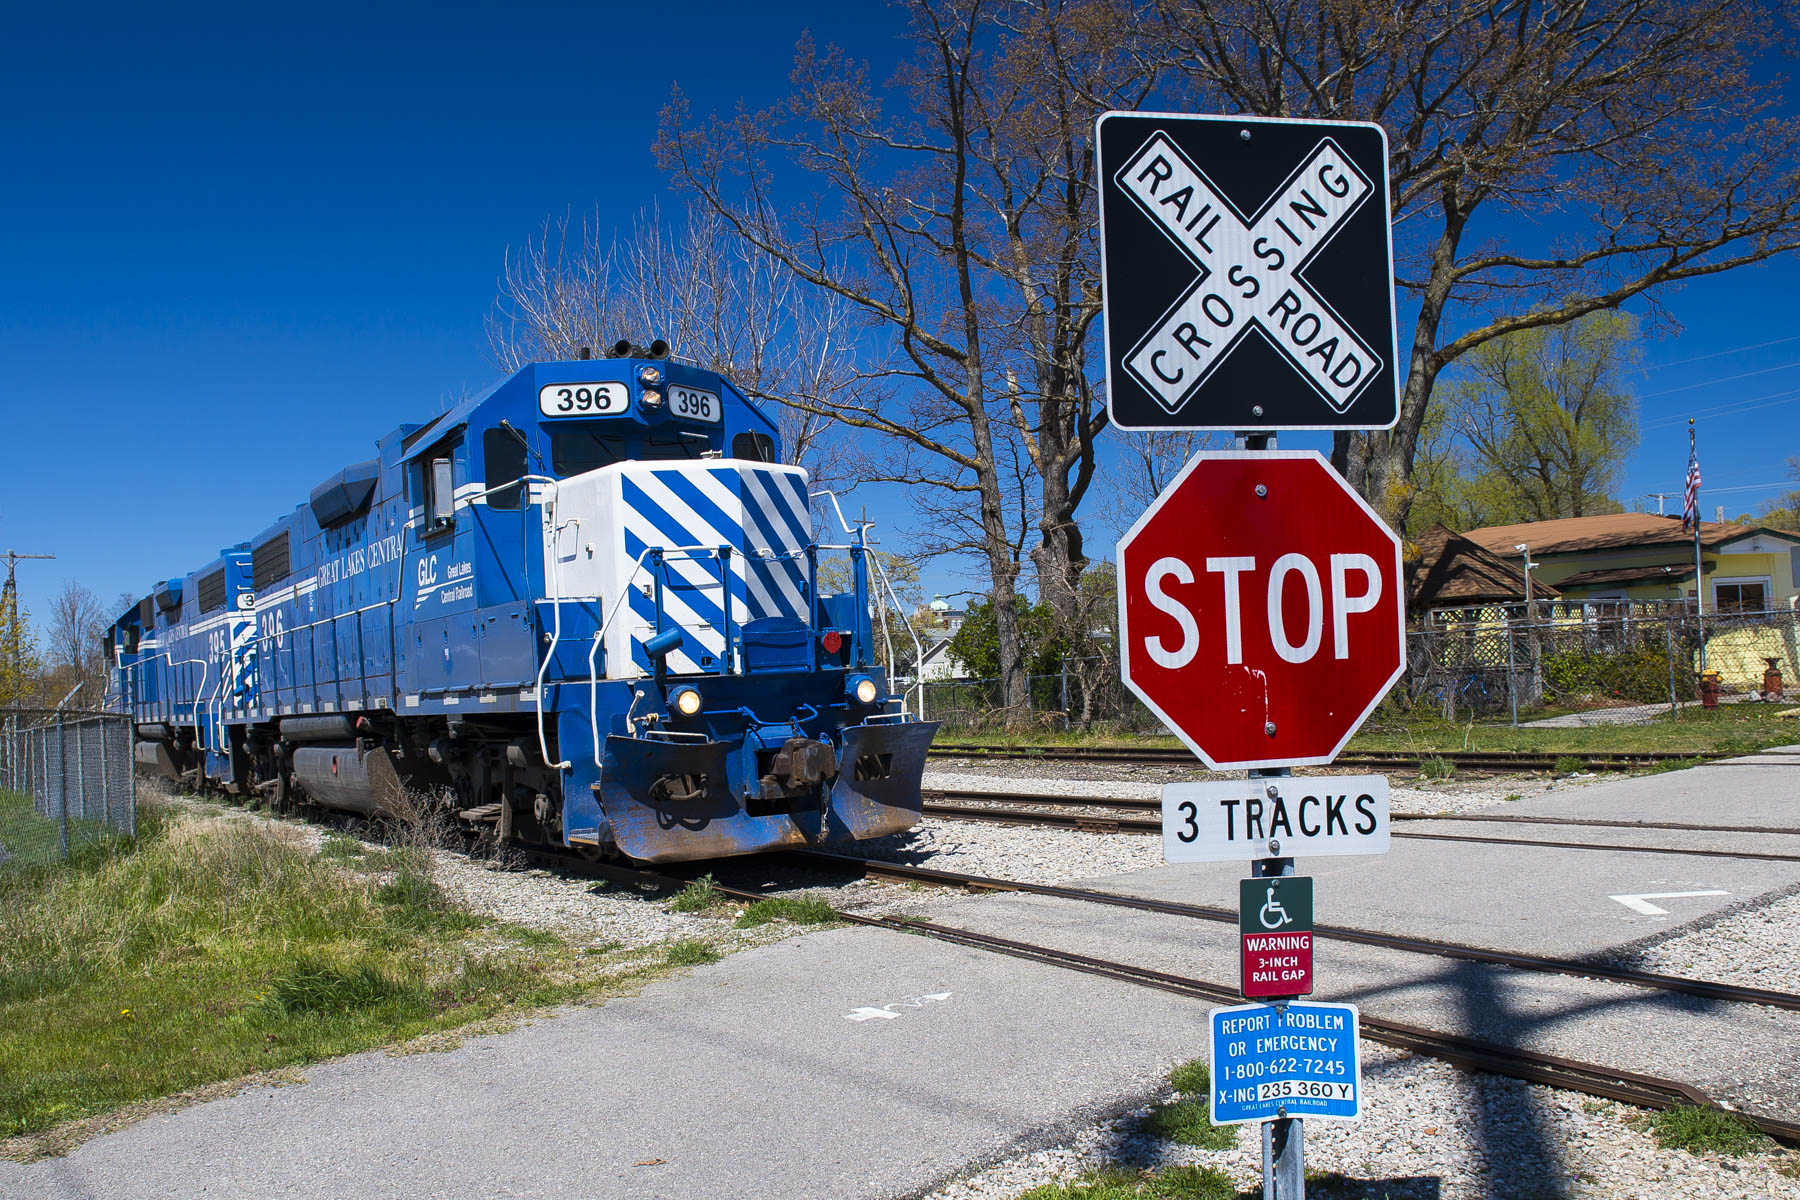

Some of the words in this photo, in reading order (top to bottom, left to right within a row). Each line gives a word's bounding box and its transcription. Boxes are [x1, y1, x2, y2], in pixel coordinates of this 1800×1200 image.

[1137, 153, 1221, 255] RAIL
[1267, 288, 1362, 389] ROAD
[1150, 164, 1350, 385] CROSSING
[557, 387, 612, 411] 396
[678, 390, 711, 418] 396
[317, 559, 340, 588] GREAT
[342, 548, 365, 580] LAKES
[418, 554, 437, 587] GLC
[447, 564, 459, 579] Great
[459, 561, 472, 576] Lakes
[1144, 553, 1382, 669] STOP
[261, 609, 284, 652] 396
[208, 629, 226, 664] 395
[1176, 801, 1199, 843] 3
[1220, 793, 1377, 841] TRACKS
[1247, 936, 1310, 952] WARNING
[1258, 956, 1298, 969] 3-INCH
[1252, 971, 1278, 982] RAIL
[1281, 969, 1306, 982] GAP
[1222, 1015, 1270, 1035] REPORT
[1229, 1041, 1246, 1057] OR
[1256, 1035, 1338, 1054] EMERGENCY
[1225, 1057, 1346, 1081] 1-800-622-7245
[1219, 1087, 1255, 1105] X-ING
[1262, 1081, 1292, 1099] 235
[1298, 1082, 1333, 1097] 360
[1299, 1099, 1328, 1107] RAILROAD
